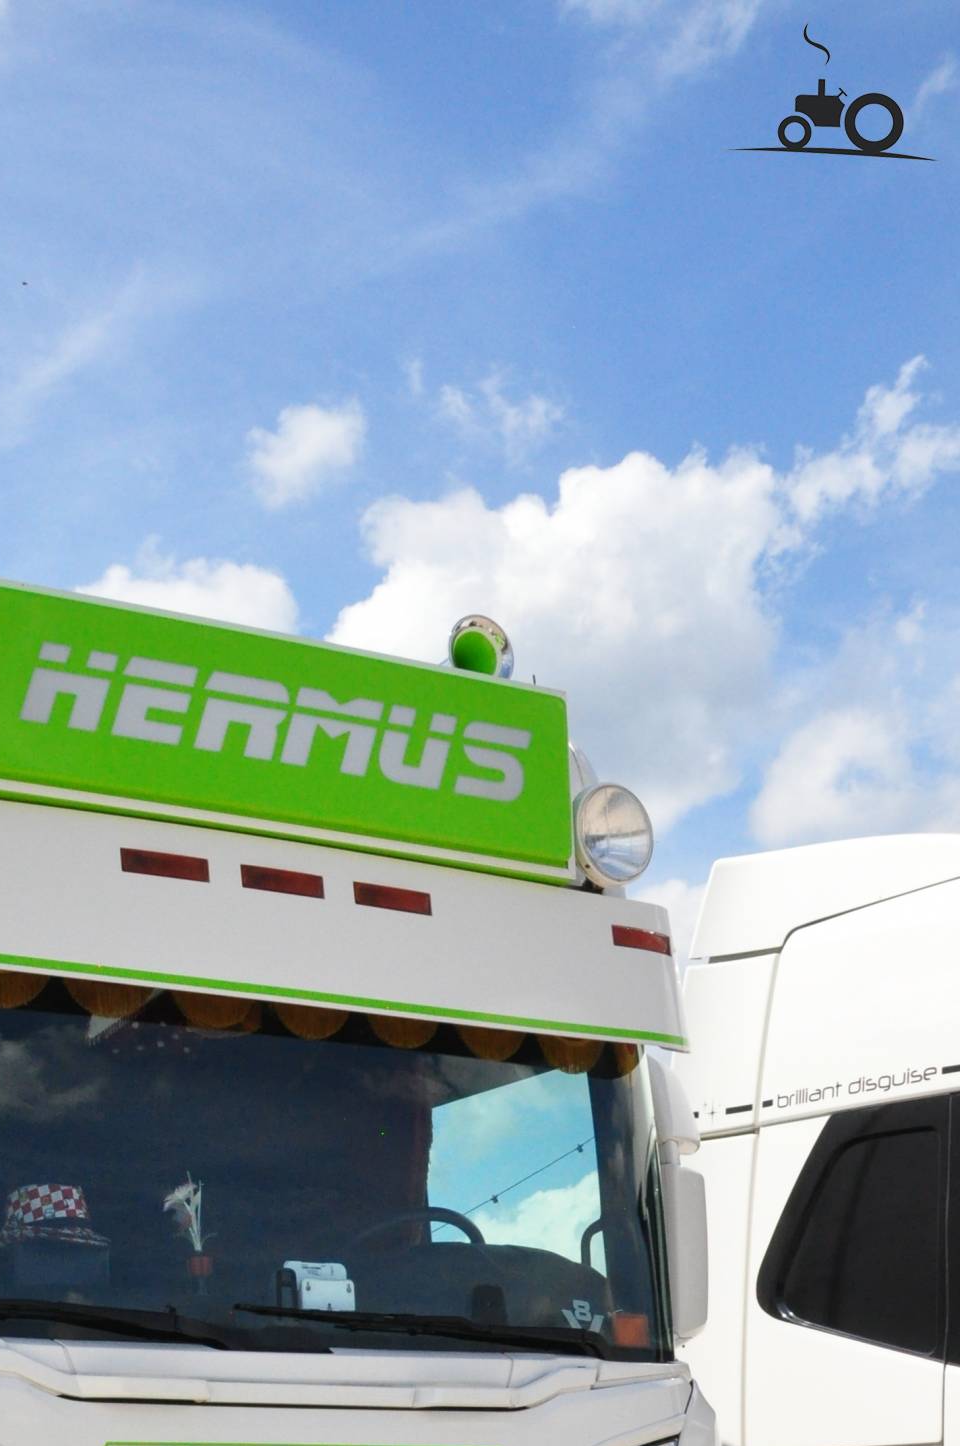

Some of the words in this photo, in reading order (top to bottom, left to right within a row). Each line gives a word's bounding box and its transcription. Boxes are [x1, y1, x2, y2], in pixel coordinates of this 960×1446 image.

[19, 641, 533, 802] HERMUS
[776, 1081, 842, 1109] brilliant
[848, 1066, 938, 1094] disguise
